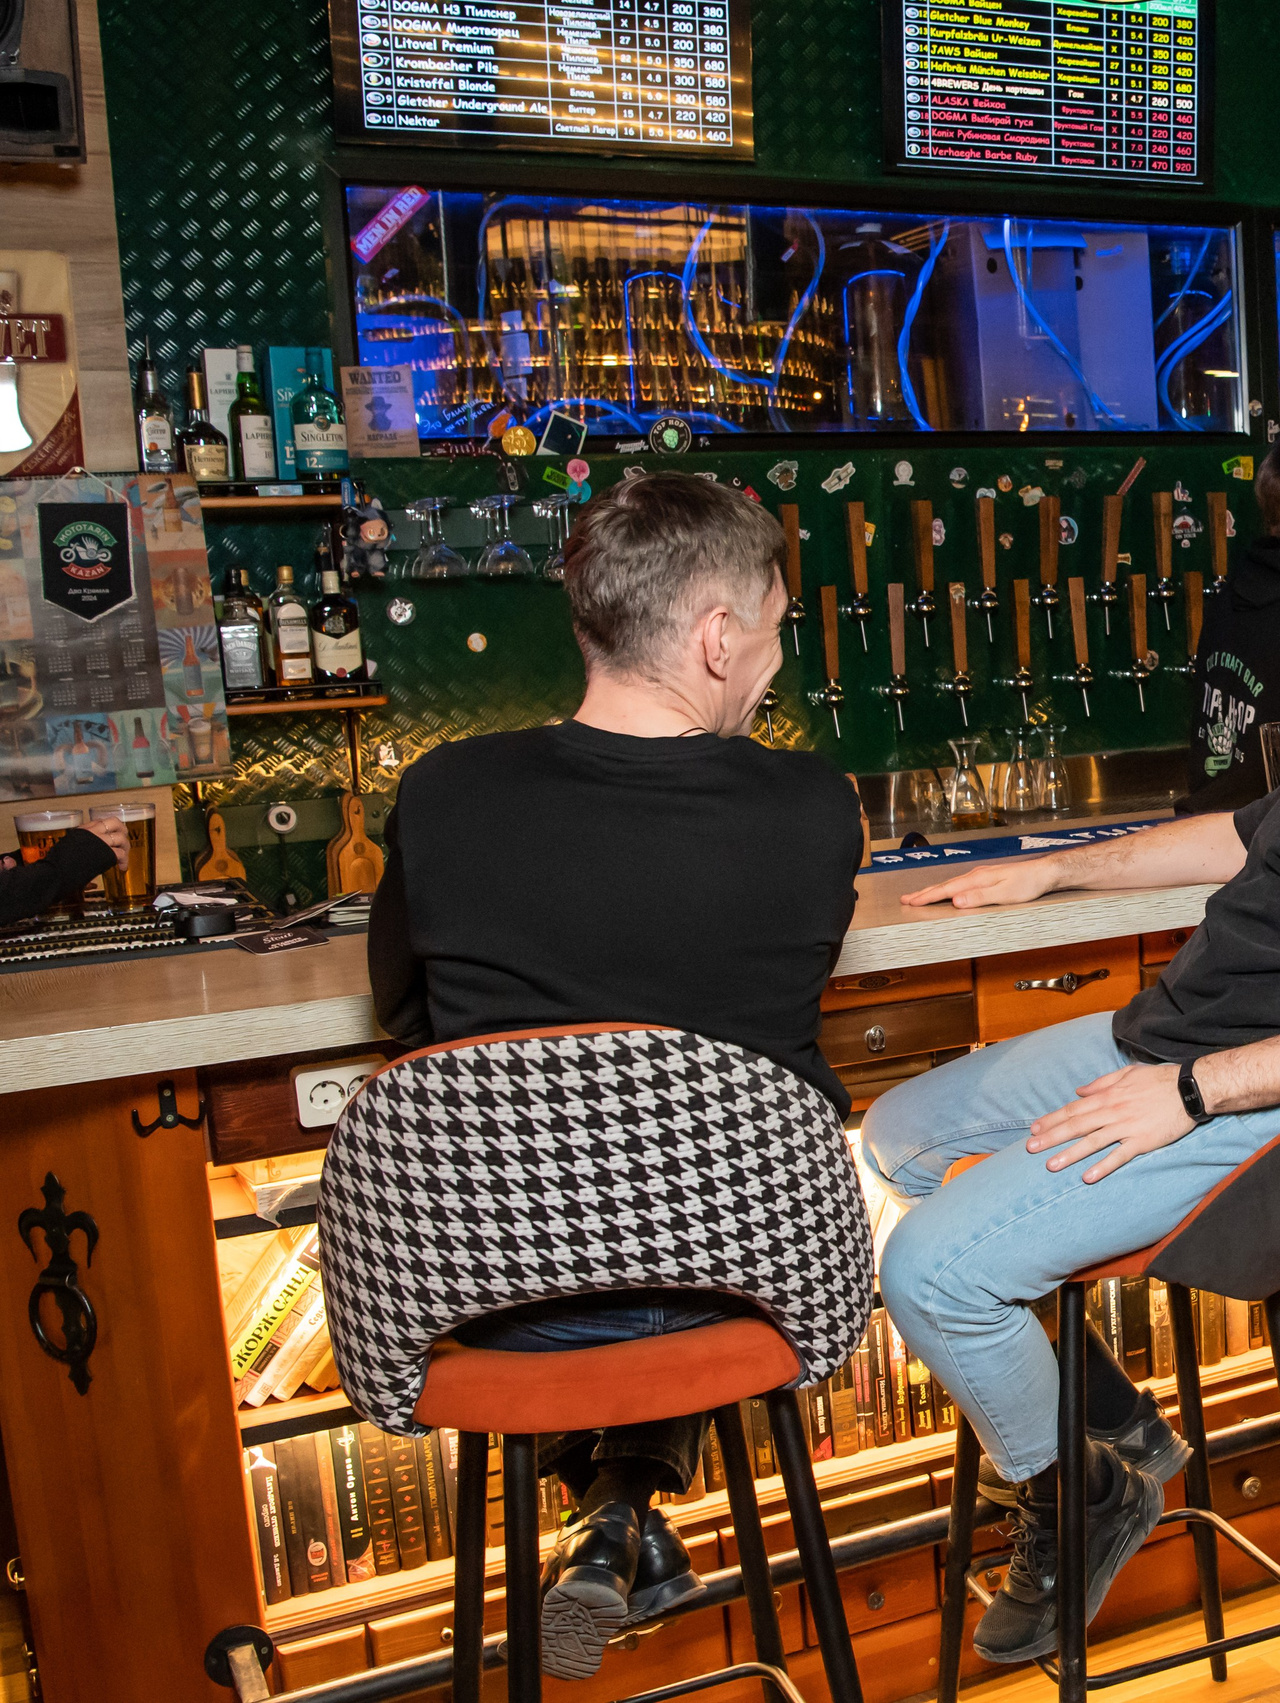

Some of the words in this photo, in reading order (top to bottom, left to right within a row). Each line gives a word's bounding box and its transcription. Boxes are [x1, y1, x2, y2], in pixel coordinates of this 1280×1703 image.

[393, 0, 439, 13] DOGMA
[465, 5, 516, 21] Пилснер
[673, 22, 693, 33] 200
[704, 25, 723, 36] 380
[672, 5, 693, 15] 200
[703, 8, 723, 18] 380
[1152, 17, 1168, 26] 200
[1176, 20, 1192, 29] 380
[393, 18, 441, 32] DOGMA
[447, 23, 519, 39] Миротворец
[673, 40, 693, 50] 200
[704, 42, 724, 53] 380
[930, 10, 970, 23] Gletcher
[973, 14, 992, 25] Blue
[996, 18, 1030, 31] Monkey
[1153, 33, 1169, 43] 220
[1177, 36, 1193, 46] 420
[395, 37, 437, 50] Litovel
[442, 40, 494, 54] Premium
[674, 58, 694, 68] 350
[705, 61, 725, 71] 680
[930, 45, 961, 56] JAWS
[964, 47, 998, 60] Вайцен
[1152, 65, 1168, 75] 220
[1176, 68, 1192, 77] 420
[991, 33, 1041, 46] Ur-Weizen
[1153, 50, 1169, 60] 350
[1176, 52, 1193, 61] 680
[395, 56, 473, 71] Krombacher
[478, 61, 499, 74] Pils
[675, 76, 695, 86] 300
[705, 78, 725, 88] 580
[930, 61, 967, 73] Hofbräu
[970, 65, 1006, 76] München
[1009, 69, 1050, 80] Weissbier
[1152, 81, 1168, 91] 350
[1176, 83, 1192, 94] 680
[397, 77, 454, 89] Kristoffel
[459, 79, 496, 92] Blonde
[706, 96, 726, 106] 580
[931, 79, 979, 90] 4BREWERS
[1152, 97, 1168, 107] 260
[1176, 99, 1193, 109] 500
[398, 96, 448, 108] Gletcher
[453, 99, 525, 114] Underground
[530, 103, 547, 113] Ale
[676, 111, 696, 121] 220
[706, 112, 726, 123] 420
[932, 96, 969, 107] ALASKA
[1152, 113, 1168, 122] 240
[1176, 115, 1192, 124] 460
[399, 115, 440, 127] Nektar
[706, 131, 726, 141] 460
[931, 112, 967, 122] DOGMA
[971, 115, 1011, 125] Выбирай
[1015, 118, 1033, 128] гуся
[1152, 129, 1168, 138] 220
[1177, 131, 1192, 141] 420
[932, 129, 954, 138] Konix
[957, 130, 1001, 142] Рубиновая
[1004, 133, 1050, 145] Смородина
[1152, 145, 1168, 154] 240
[1176, 147, 1191, 156] 460
[932, 147, 981, 160] Verhaeghe
[985, 150, 1012, 160] Barbe
[1016, 153, 1038, 163] Ruby
[1152, 161, 1168, 170] 470
[1175, 163, 1191, 172] 920
[356, 223, 386, 255] MEN
[379, 209, 400, 231] IN
[396, 187, 422, 212] RED
[348, 371, 402, 384] WANTED
[301, 431, 344, 443] SINGLETON
[59, 522, 110, 543] MOTOTARIN
[70, 566, 105, 577] KAZAN
[1220, 651, 1244, 677] CRAFT
[1243, 668, 1264, 698] BAR
[232, 1314, 278, 1369] ЖОРЖ
[272, 1264, 311, 1312] САНД
[345, 1457, 356, 1489] Орлов
[349, 1490, 360, 1521] Антон
